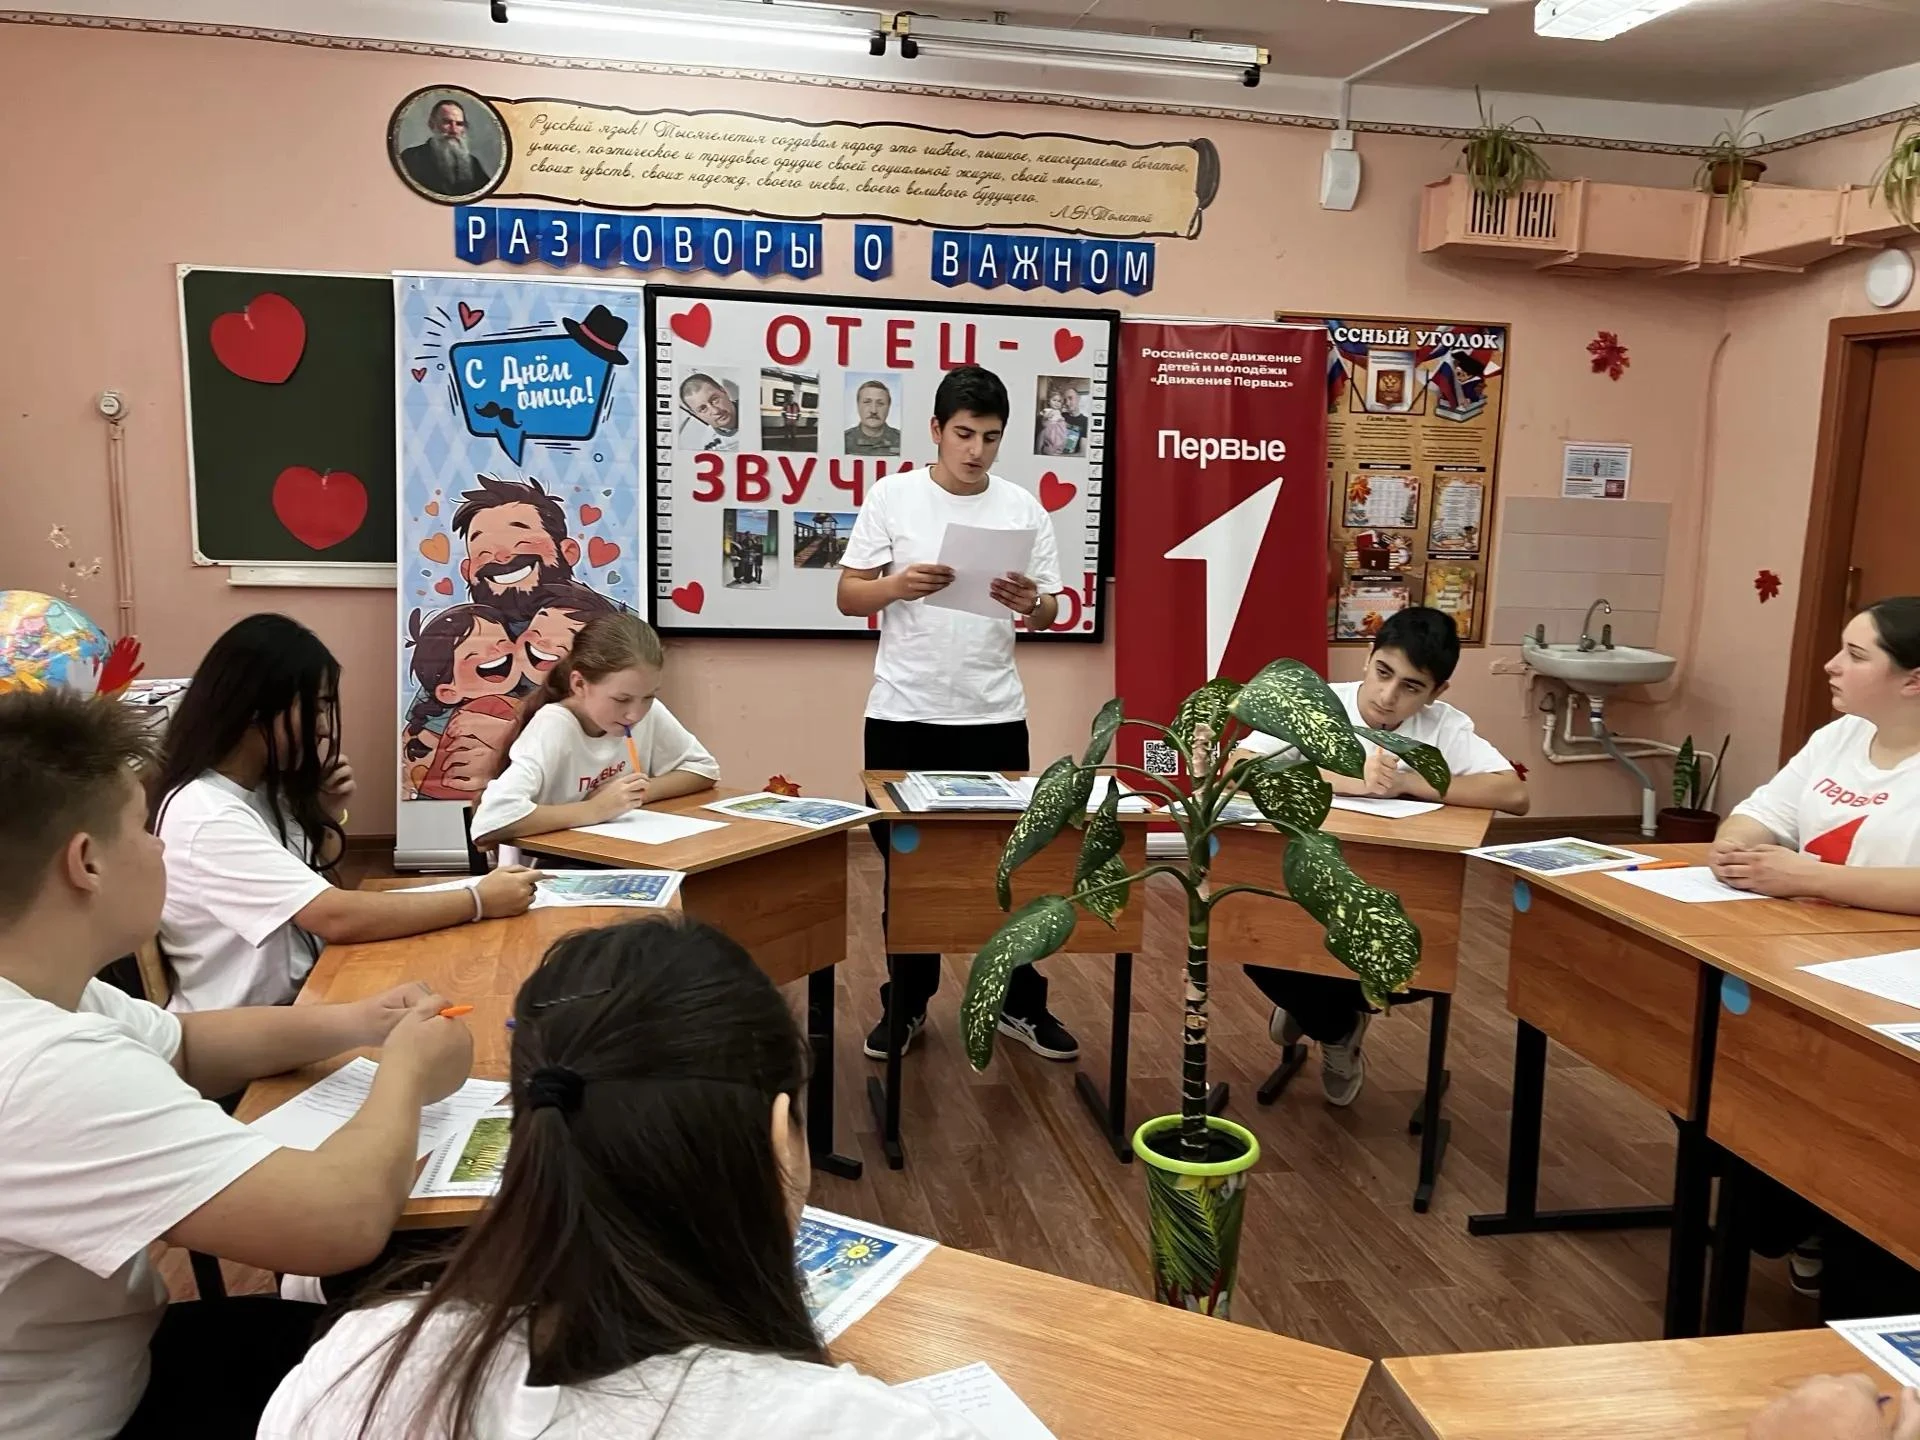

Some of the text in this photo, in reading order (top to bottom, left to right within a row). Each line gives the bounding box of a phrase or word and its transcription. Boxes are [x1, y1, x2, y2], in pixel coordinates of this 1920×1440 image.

[529, 113, 594, 135] Русский
[599, 120, 648, 140] язык!
[653, 120, 767, 145] Тысячелетия
[772, 132, 837, 152] создавал
[841, 141, 883, 157] народ
[889, 143, 917, 155] это
[923, 140, 971, 159] гибкое,
[975, 150, 1032, 163] пышное,
[1036, 153, 1127, 170] неисчерпаемо
[526, 141, 581, 157] умное,
[586, 143, 680, 160] поэтическое
[685, 151, 695, 161] и
[699, 149, 768, 169] трудовое
[773, 157, 823, 172] орудие
[827, 154, 866, 172] своей
[871, 163, 951, 179] социальной
[1011, 167, 1048, 183] своей
[530, 157, 574, 174] своих
[642, 164, 684, 181] своих
[756, 171, 802, 189] своего
[855, 178, 900, 194] своего
[906, 180, 968, 198] великого
[468, 214, 1148, 286] РАЗГОВОРЫ О ВАЖНОМ
[1142, 347, 1302, 364] Российское движение
[1416, 331, 1499, 349] УГОЛОК
[465, 355, 573, 393] С Днём
[1151, 374, 1294, 389] «Движение Первых»
[1158, 362, 1288, 376] детей и молодёжи
[517, 376, 595, 411] отца!
[1158, 430, 1286, 469] Первые
[692, 453, 939, 507] ЗВУЧ
